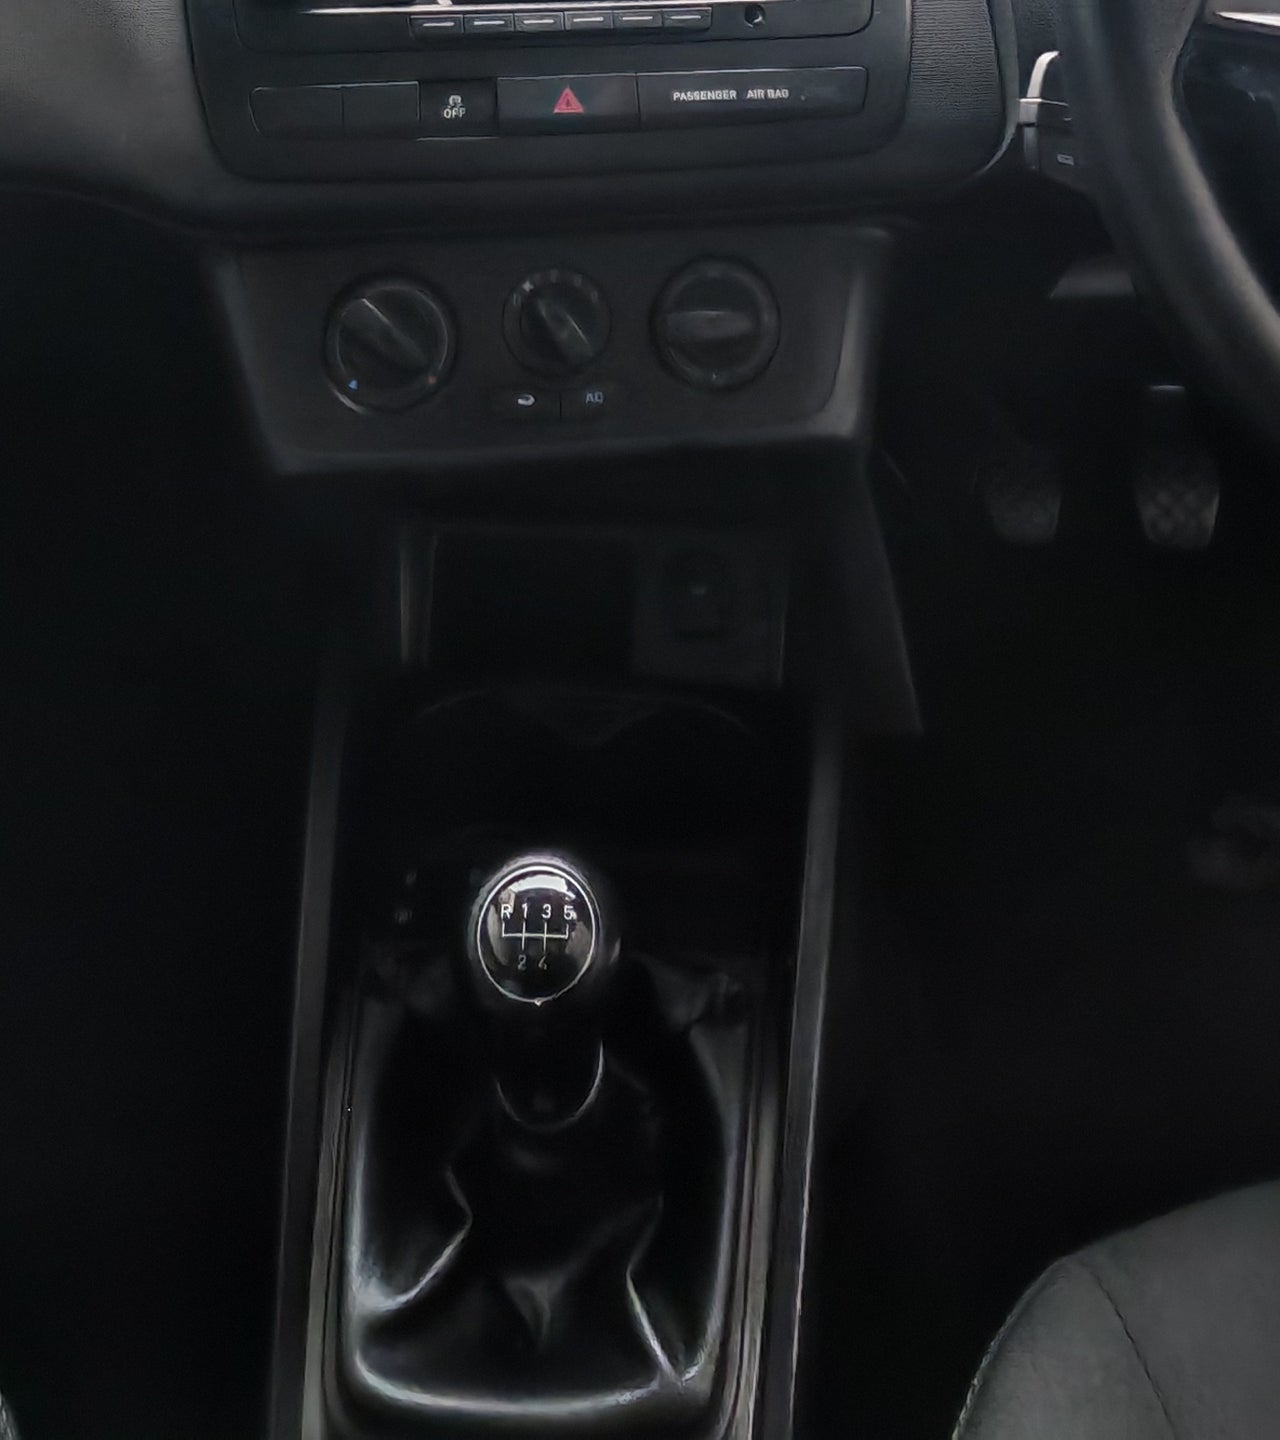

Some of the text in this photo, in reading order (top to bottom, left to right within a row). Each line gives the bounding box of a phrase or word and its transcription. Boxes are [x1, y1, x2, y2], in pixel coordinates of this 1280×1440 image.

[673, 89, 737, 101] PASSENGER
[443, 107, 466, 119] OFF
[501, 903, 575, 920] R 1 3 5
[517, 954, 548, 971] 2 4
